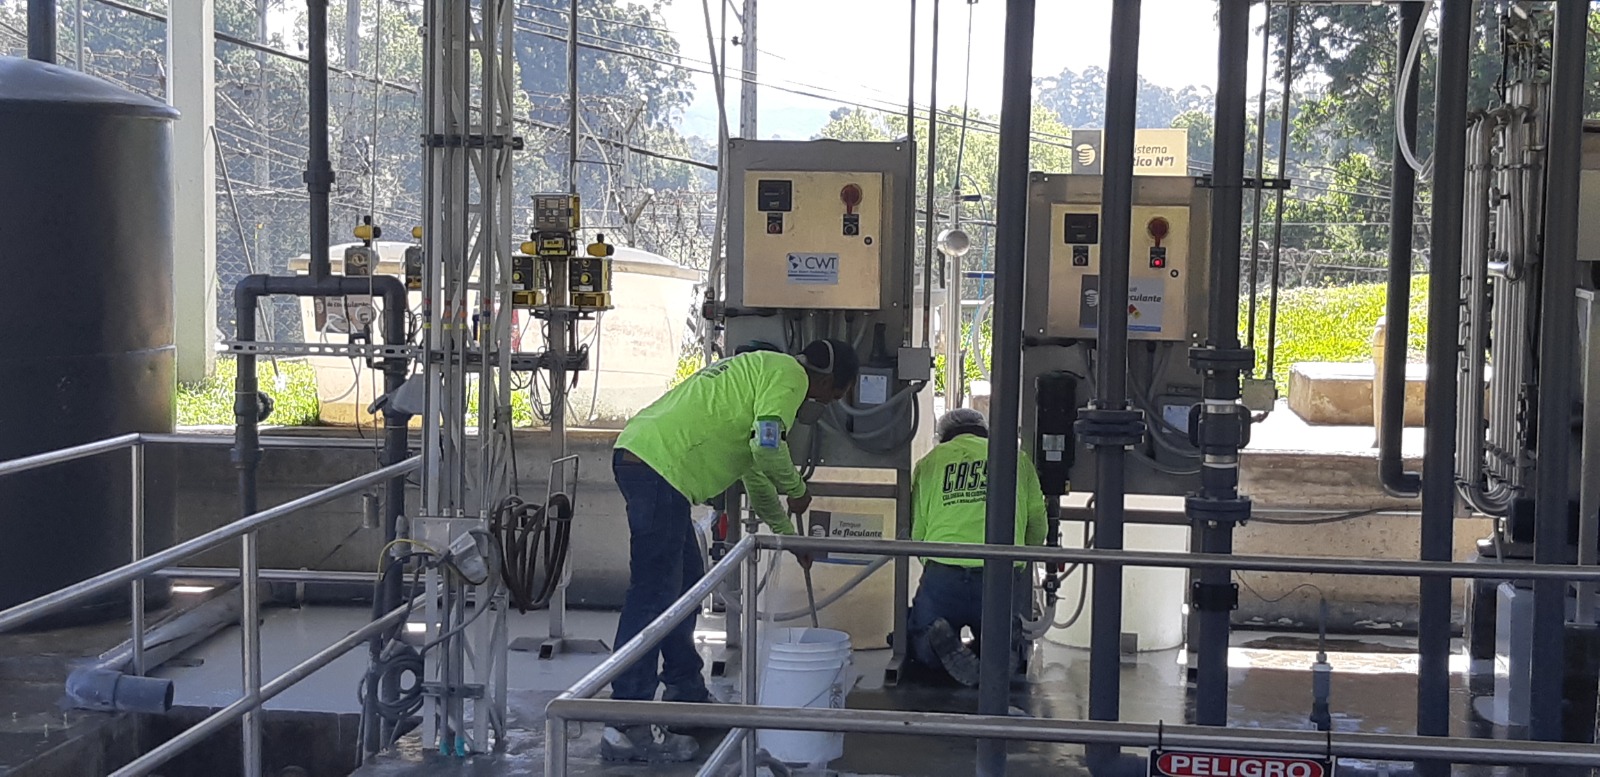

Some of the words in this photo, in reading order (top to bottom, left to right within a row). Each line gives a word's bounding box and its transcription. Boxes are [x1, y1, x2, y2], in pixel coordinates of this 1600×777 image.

[1134, 144, 1168, 154] istema
[805, 256, 837, 270] CWT
[1129, 293, 1162, 303] culante
[843, 528, 883, 538] floculante
[1170, 755, 1312, 777] PELIGRO
